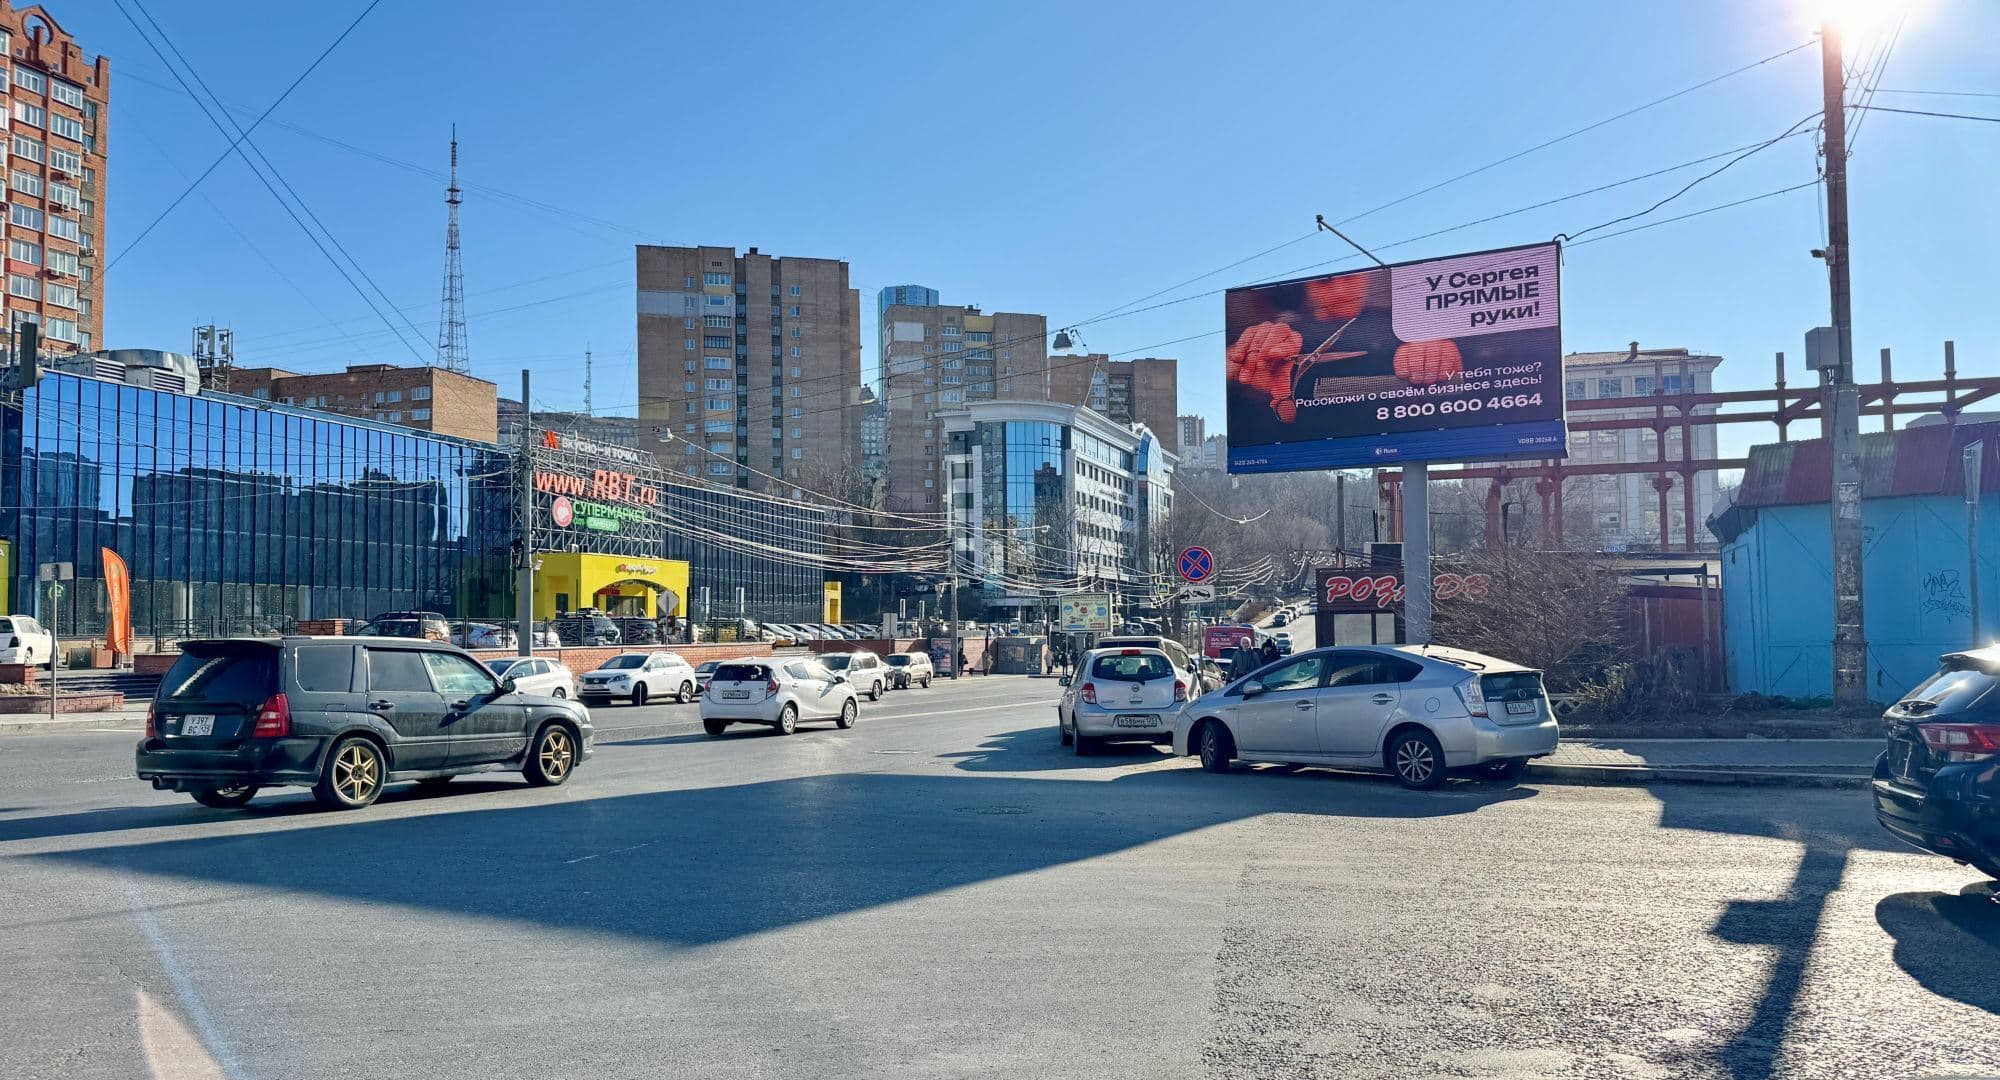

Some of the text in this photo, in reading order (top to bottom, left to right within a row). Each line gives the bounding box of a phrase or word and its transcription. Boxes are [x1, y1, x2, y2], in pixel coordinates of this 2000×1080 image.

[1426, 265, 1539, 291] У Сергея
[1426, 281, 1540, 311] ПРЯМЫЕ
[1471, 301, 1540, 327] руки!
[1445, 361, 1542, 380] У тебя тоже?
[1295, 374, 1542, 408] Расскажи о своём бизнесе здесь!
[1376, 393, 1543, 420] 8 800 600 4664
[535, 469, 657, 505] www.RBT.ru
[573, 501, 647, 523] СУПЕРМАРКЕТ
